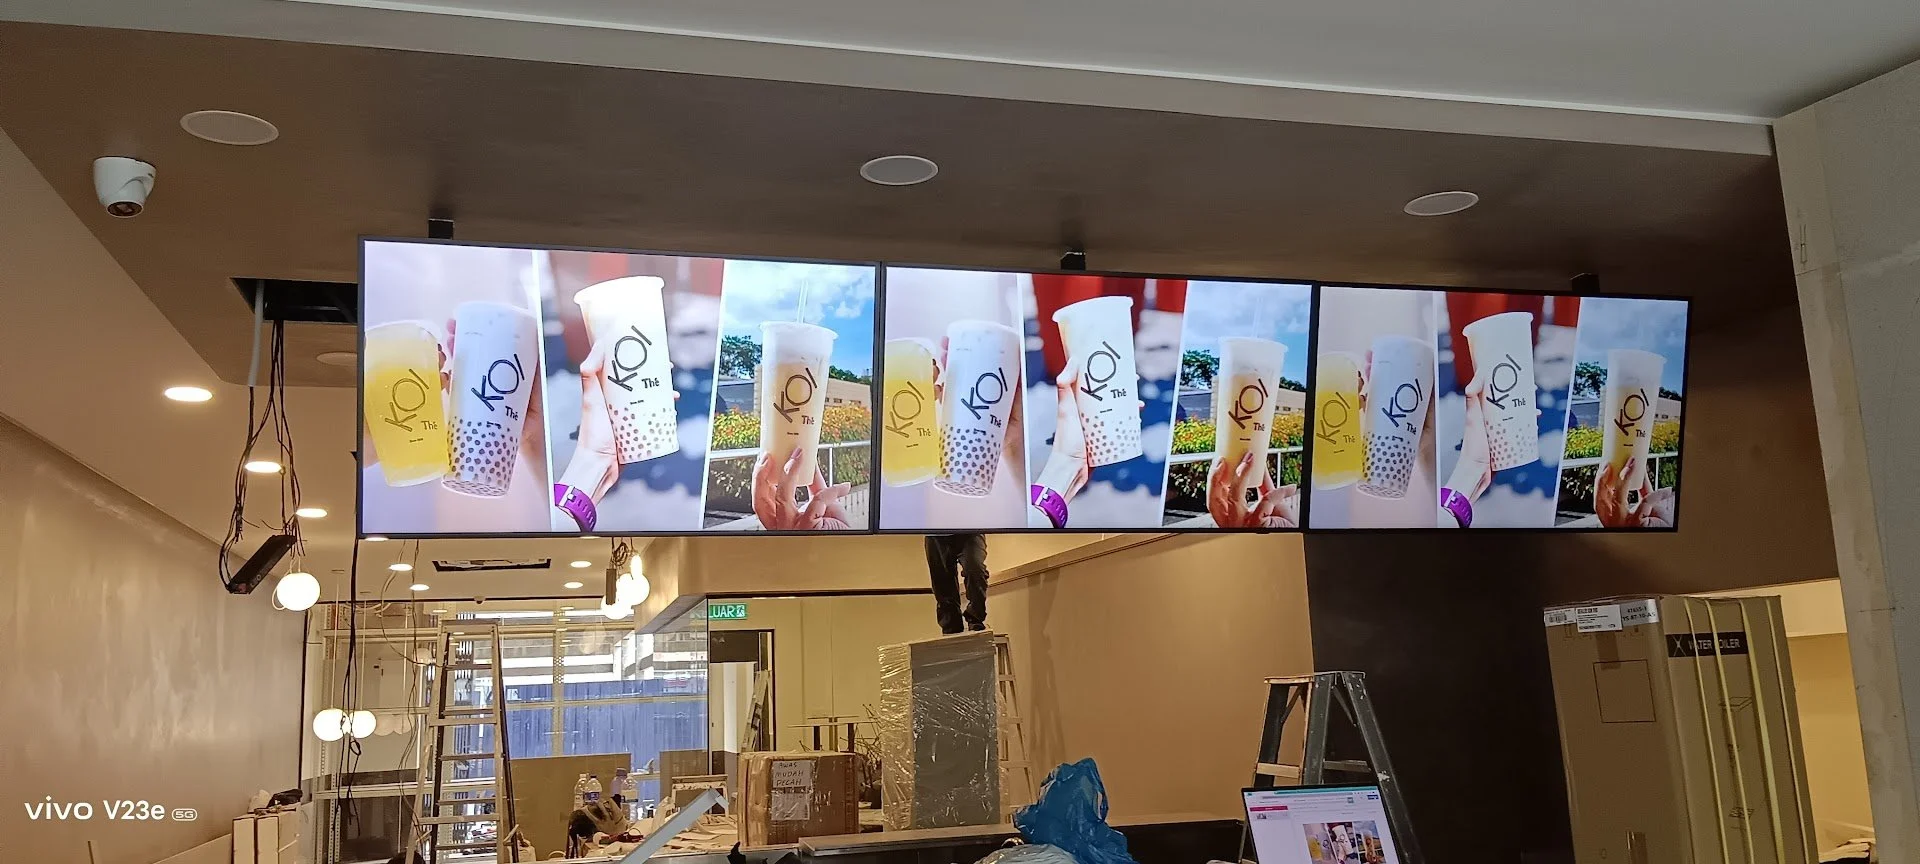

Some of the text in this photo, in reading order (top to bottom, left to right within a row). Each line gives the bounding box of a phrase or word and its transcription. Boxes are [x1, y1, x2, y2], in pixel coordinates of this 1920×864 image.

[471, 354, 525, 411] KOI
[607, 325, 652, 392] KOI
[1081, 341, 1121, 401] KOI
[1486, 354, 1522, 410] KOI
[385, 369, 429, 432] KOI
[773, 367, 817, 423] KOI
[885, 381, 924, 438] KOI
[961, 367, 1008, 420] KOI
[1228, 378, 1268, 429] KOI
[1316, 392, 1350, 445] KOI
[1382, 378, 1423, 427] KOI
[1614, 388, 1649, 436] KOI
[1718, 639, 1741, 649] OILER
